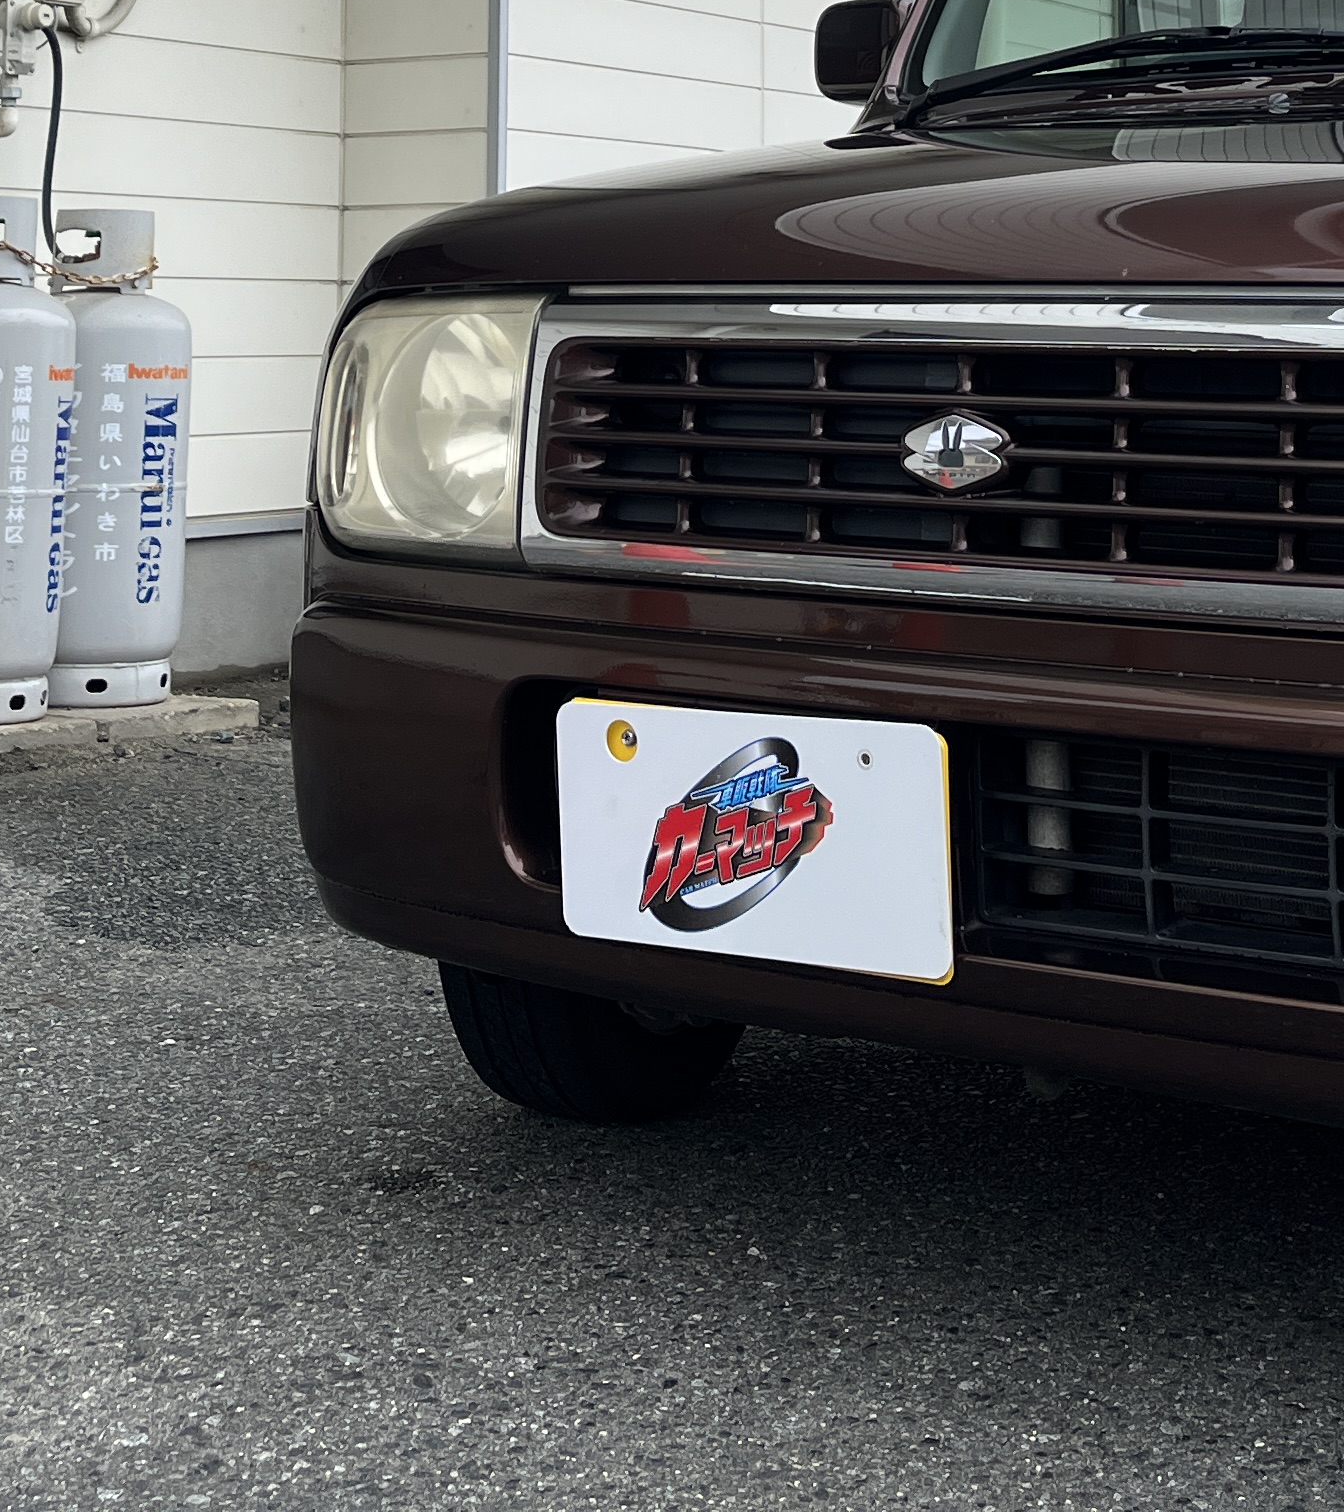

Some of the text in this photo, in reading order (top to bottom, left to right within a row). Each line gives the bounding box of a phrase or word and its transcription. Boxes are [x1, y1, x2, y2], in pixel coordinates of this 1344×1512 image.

[4, 364, 32, 545] 宮城県仙台市若林区
[93, 362, 126, 562] 福島県いわき市
[139, 392, 179, 532] Marui
[639, 784, 818, 914] カーマッチ
